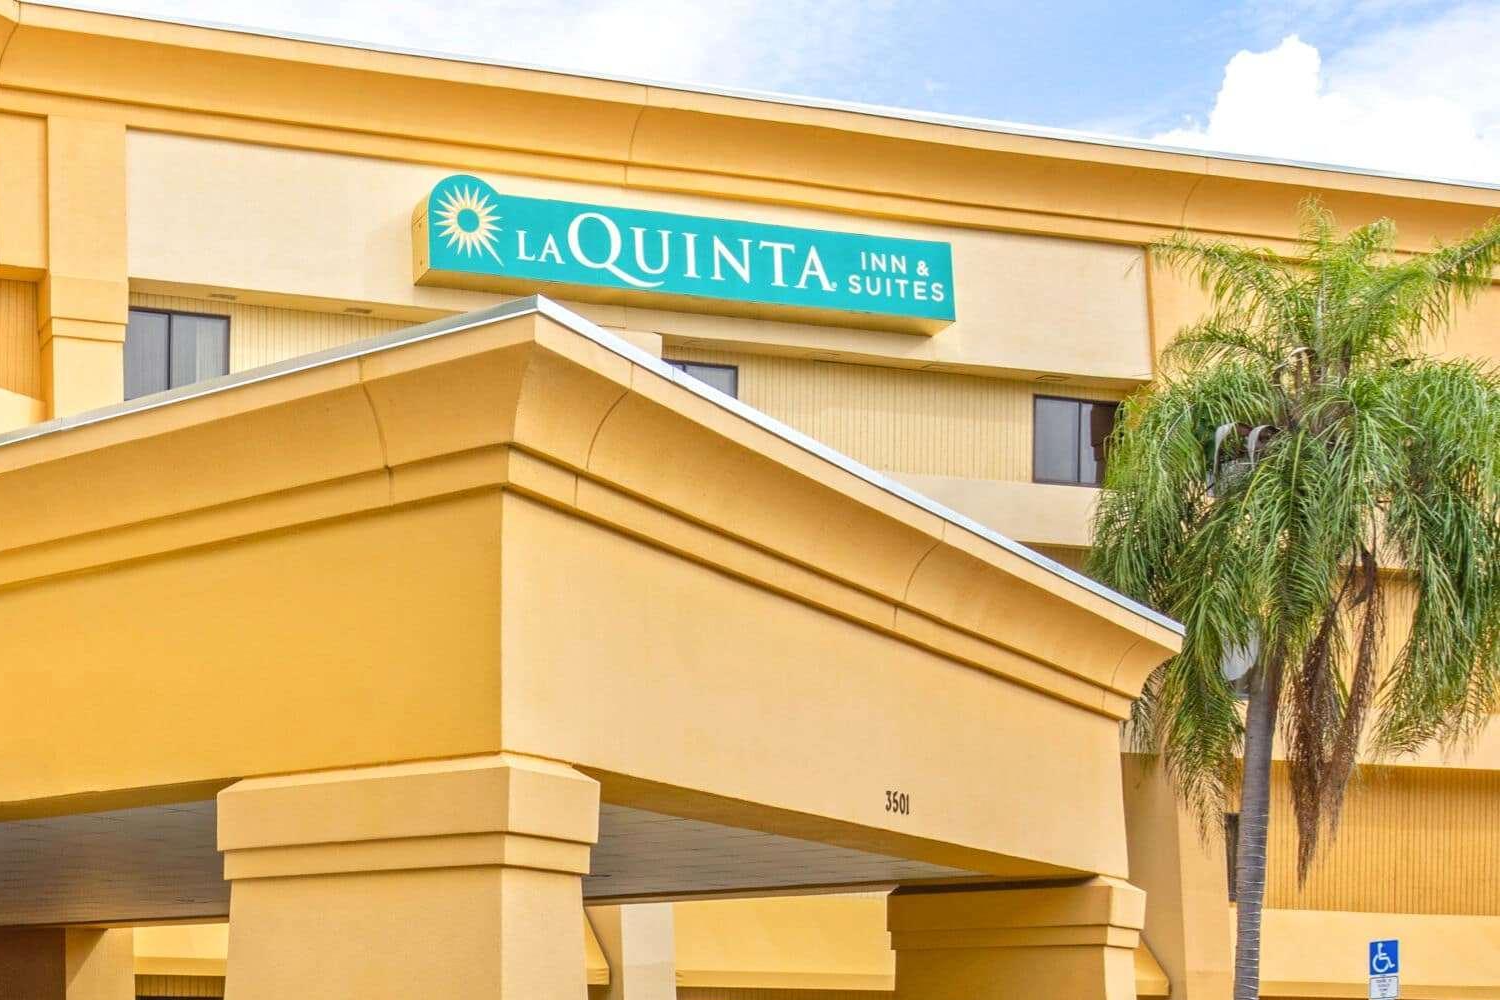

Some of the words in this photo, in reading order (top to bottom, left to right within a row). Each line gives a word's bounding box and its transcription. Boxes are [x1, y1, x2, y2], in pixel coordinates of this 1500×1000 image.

[517, 229, 564, 264] LA
[567, 212, 834, 291] QUINTA
[860, 251, 909, 274] INN
[916, 259, 930, 276] &
[847, 274, 946, 302] SUITES
[885, 790, 910, 816] 3501
